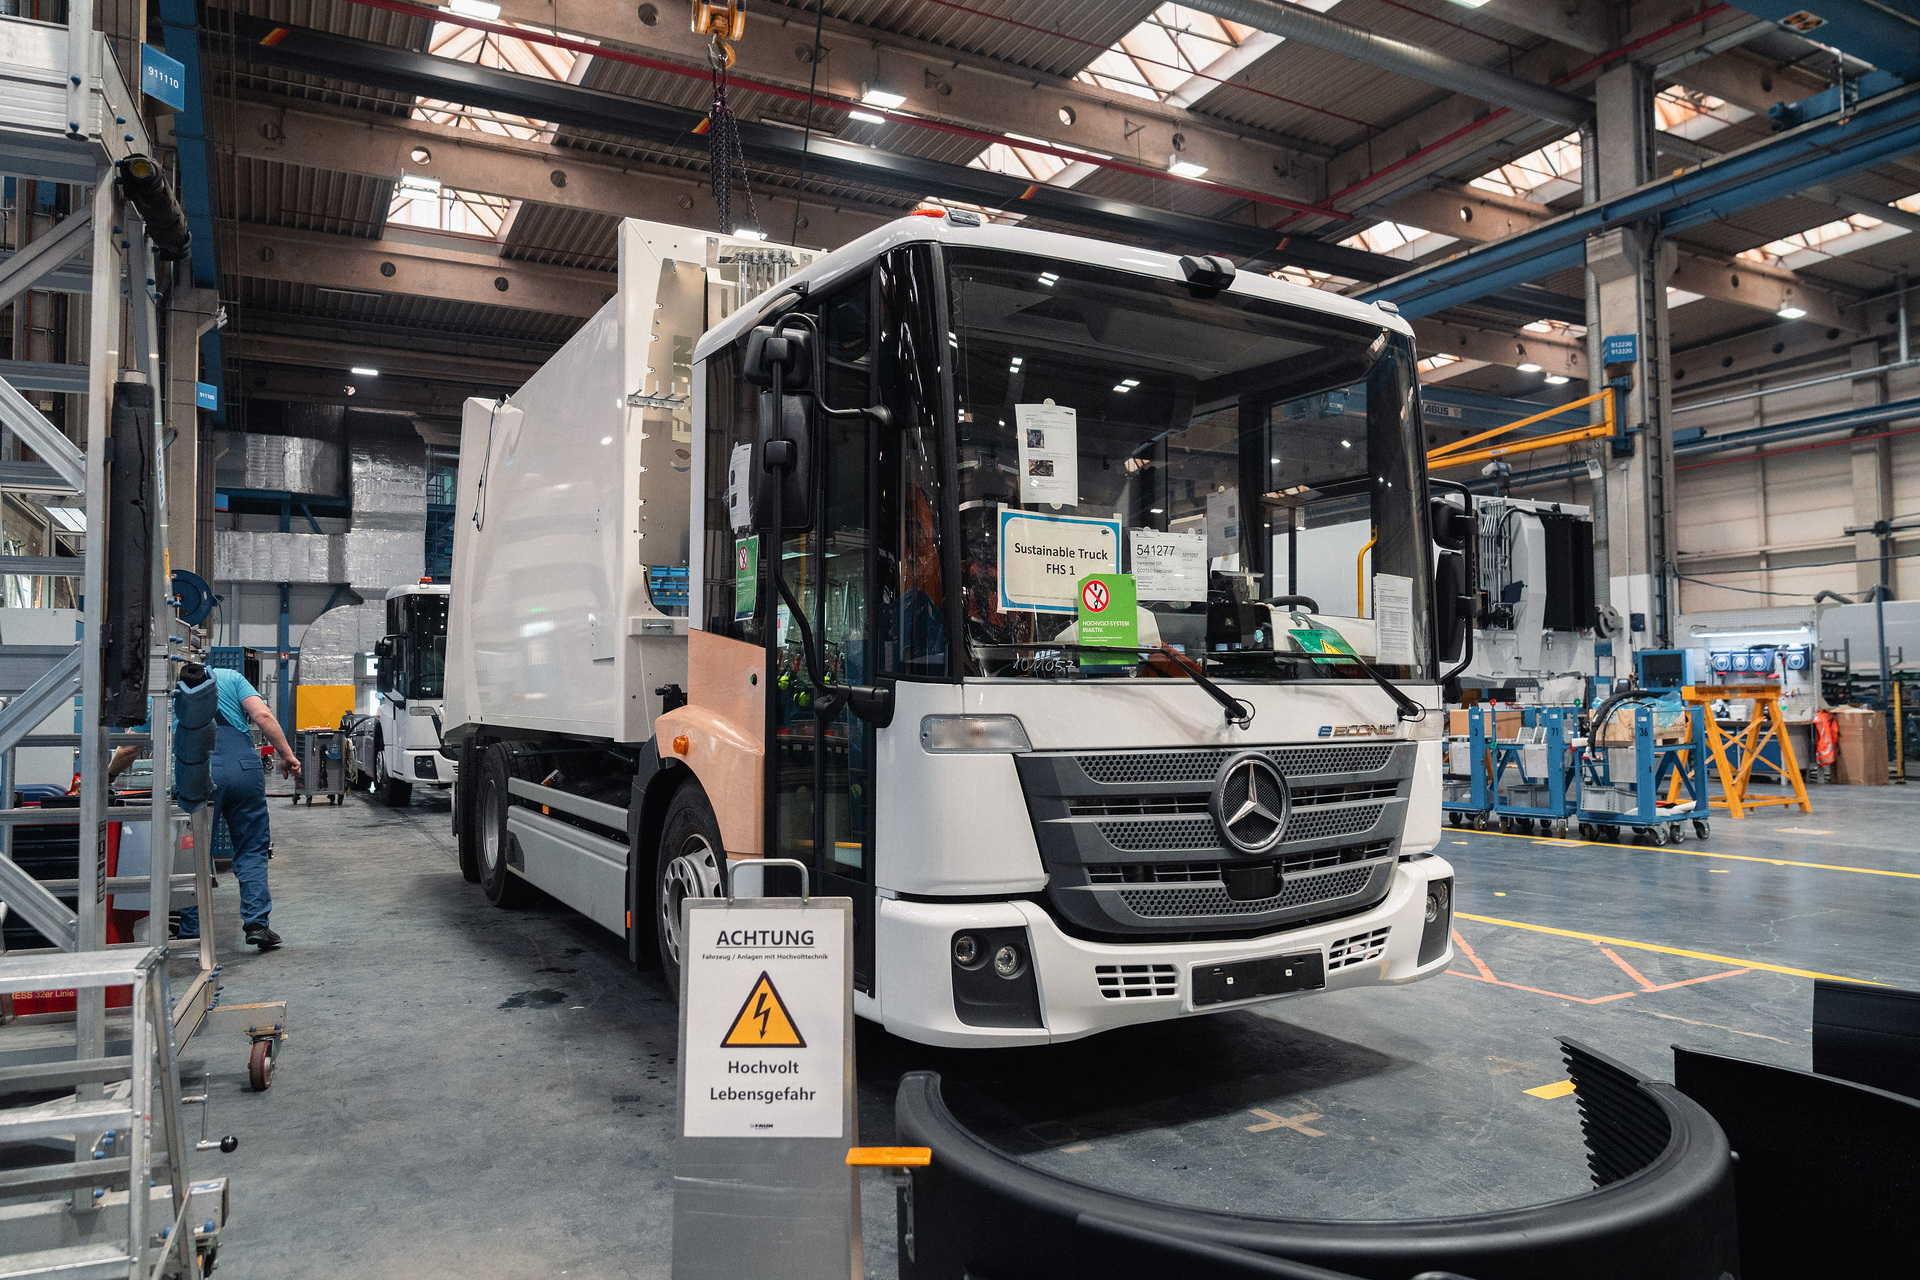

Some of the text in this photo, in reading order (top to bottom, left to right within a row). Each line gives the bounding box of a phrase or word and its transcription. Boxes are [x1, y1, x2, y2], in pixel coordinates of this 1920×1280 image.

[148, 66, 179, 89] 911110
[1424, 404, 1449, 415] ABUS
[1014, 542, 1108, 560] Sustainable Truck
[1136, 544, 1175, 557] 541277
[1046, 563, 1075, 576] FHS 1
[1012, 657, 1076, 672] 1011057
[1474, 728, 1479, 737] 3
[1551, 727, 1559, 737] 71
[1639, 728, 1649, 737] 36
[716, 930, 815, 946] ACHTUNG
[702, 953, 731, 961] Fahrzeug
[34, 991, 53, 999] 32er
[55, 990, 74, 998] Linie
[728, 1060, 799, 1074] Hochvolt
[710, 1087, 816, 1105] Lebensgefahr
